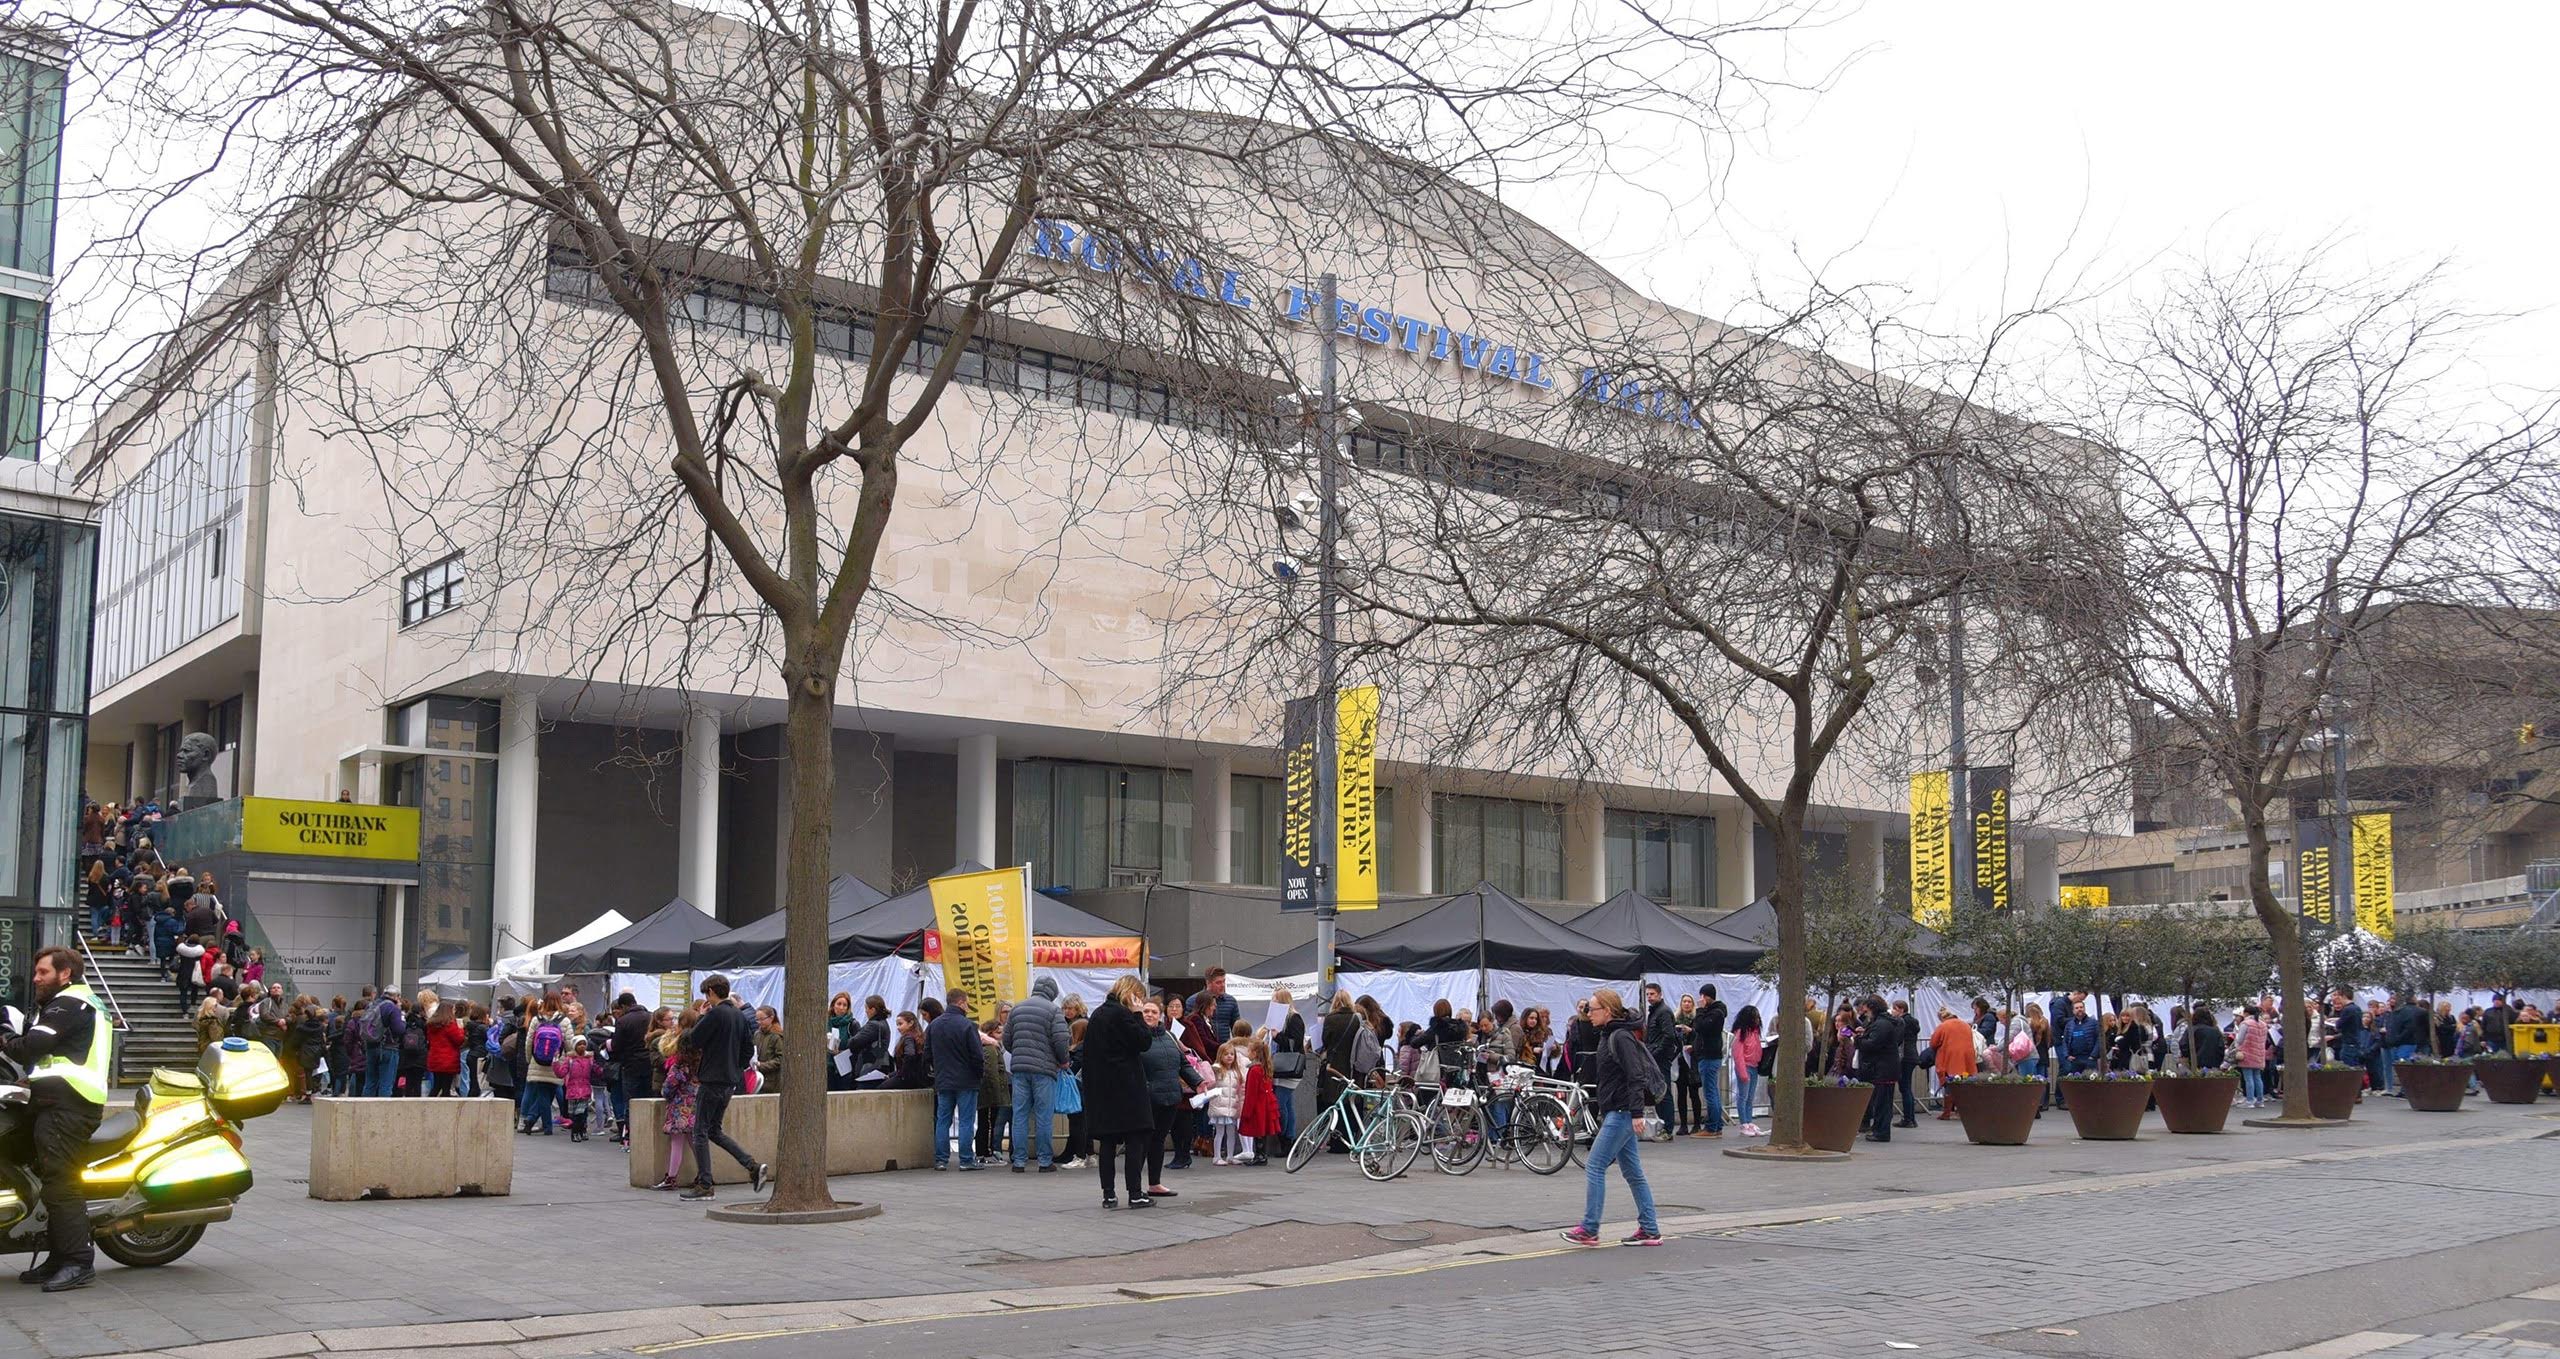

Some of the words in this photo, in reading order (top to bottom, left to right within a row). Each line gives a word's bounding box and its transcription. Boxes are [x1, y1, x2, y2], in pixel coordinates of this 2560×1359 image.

[1284, 284, 1553, 390] FESTIVAL
[279, 811, 387, 832] SOUTHBANK
[1285, 750, 1300, 861] GALLERY
[1297, 741, 1313, 868] HAYWARD
[1343, 750, 1357, 849] CENTRE
[1358, 718, 1372, 876] SOUTHBANK
[299, 829, 368, 846] CENTRE
[1931, 806, 1945, 901] HAYWARD
[1975, 812, 1992, 888] CENTRE
[1991, 788, 2008, 910] SOUTHBANK
[1287, 889, 1308, 900] OPEN
[1288, 877, 1307, 889] NOW
[2301, 851, 2317, 919] GALLERY
[2316, 847, 2331, 924] HAYWARD
[2374, 833, 2387, 929] SOUTHBANK
[0, 919, 14, 953] ping
[289, 966, 332, 976] Entrance
[316, 955, 336, 965] Hall
[1034, 948, 1107, 964] TARIAN
